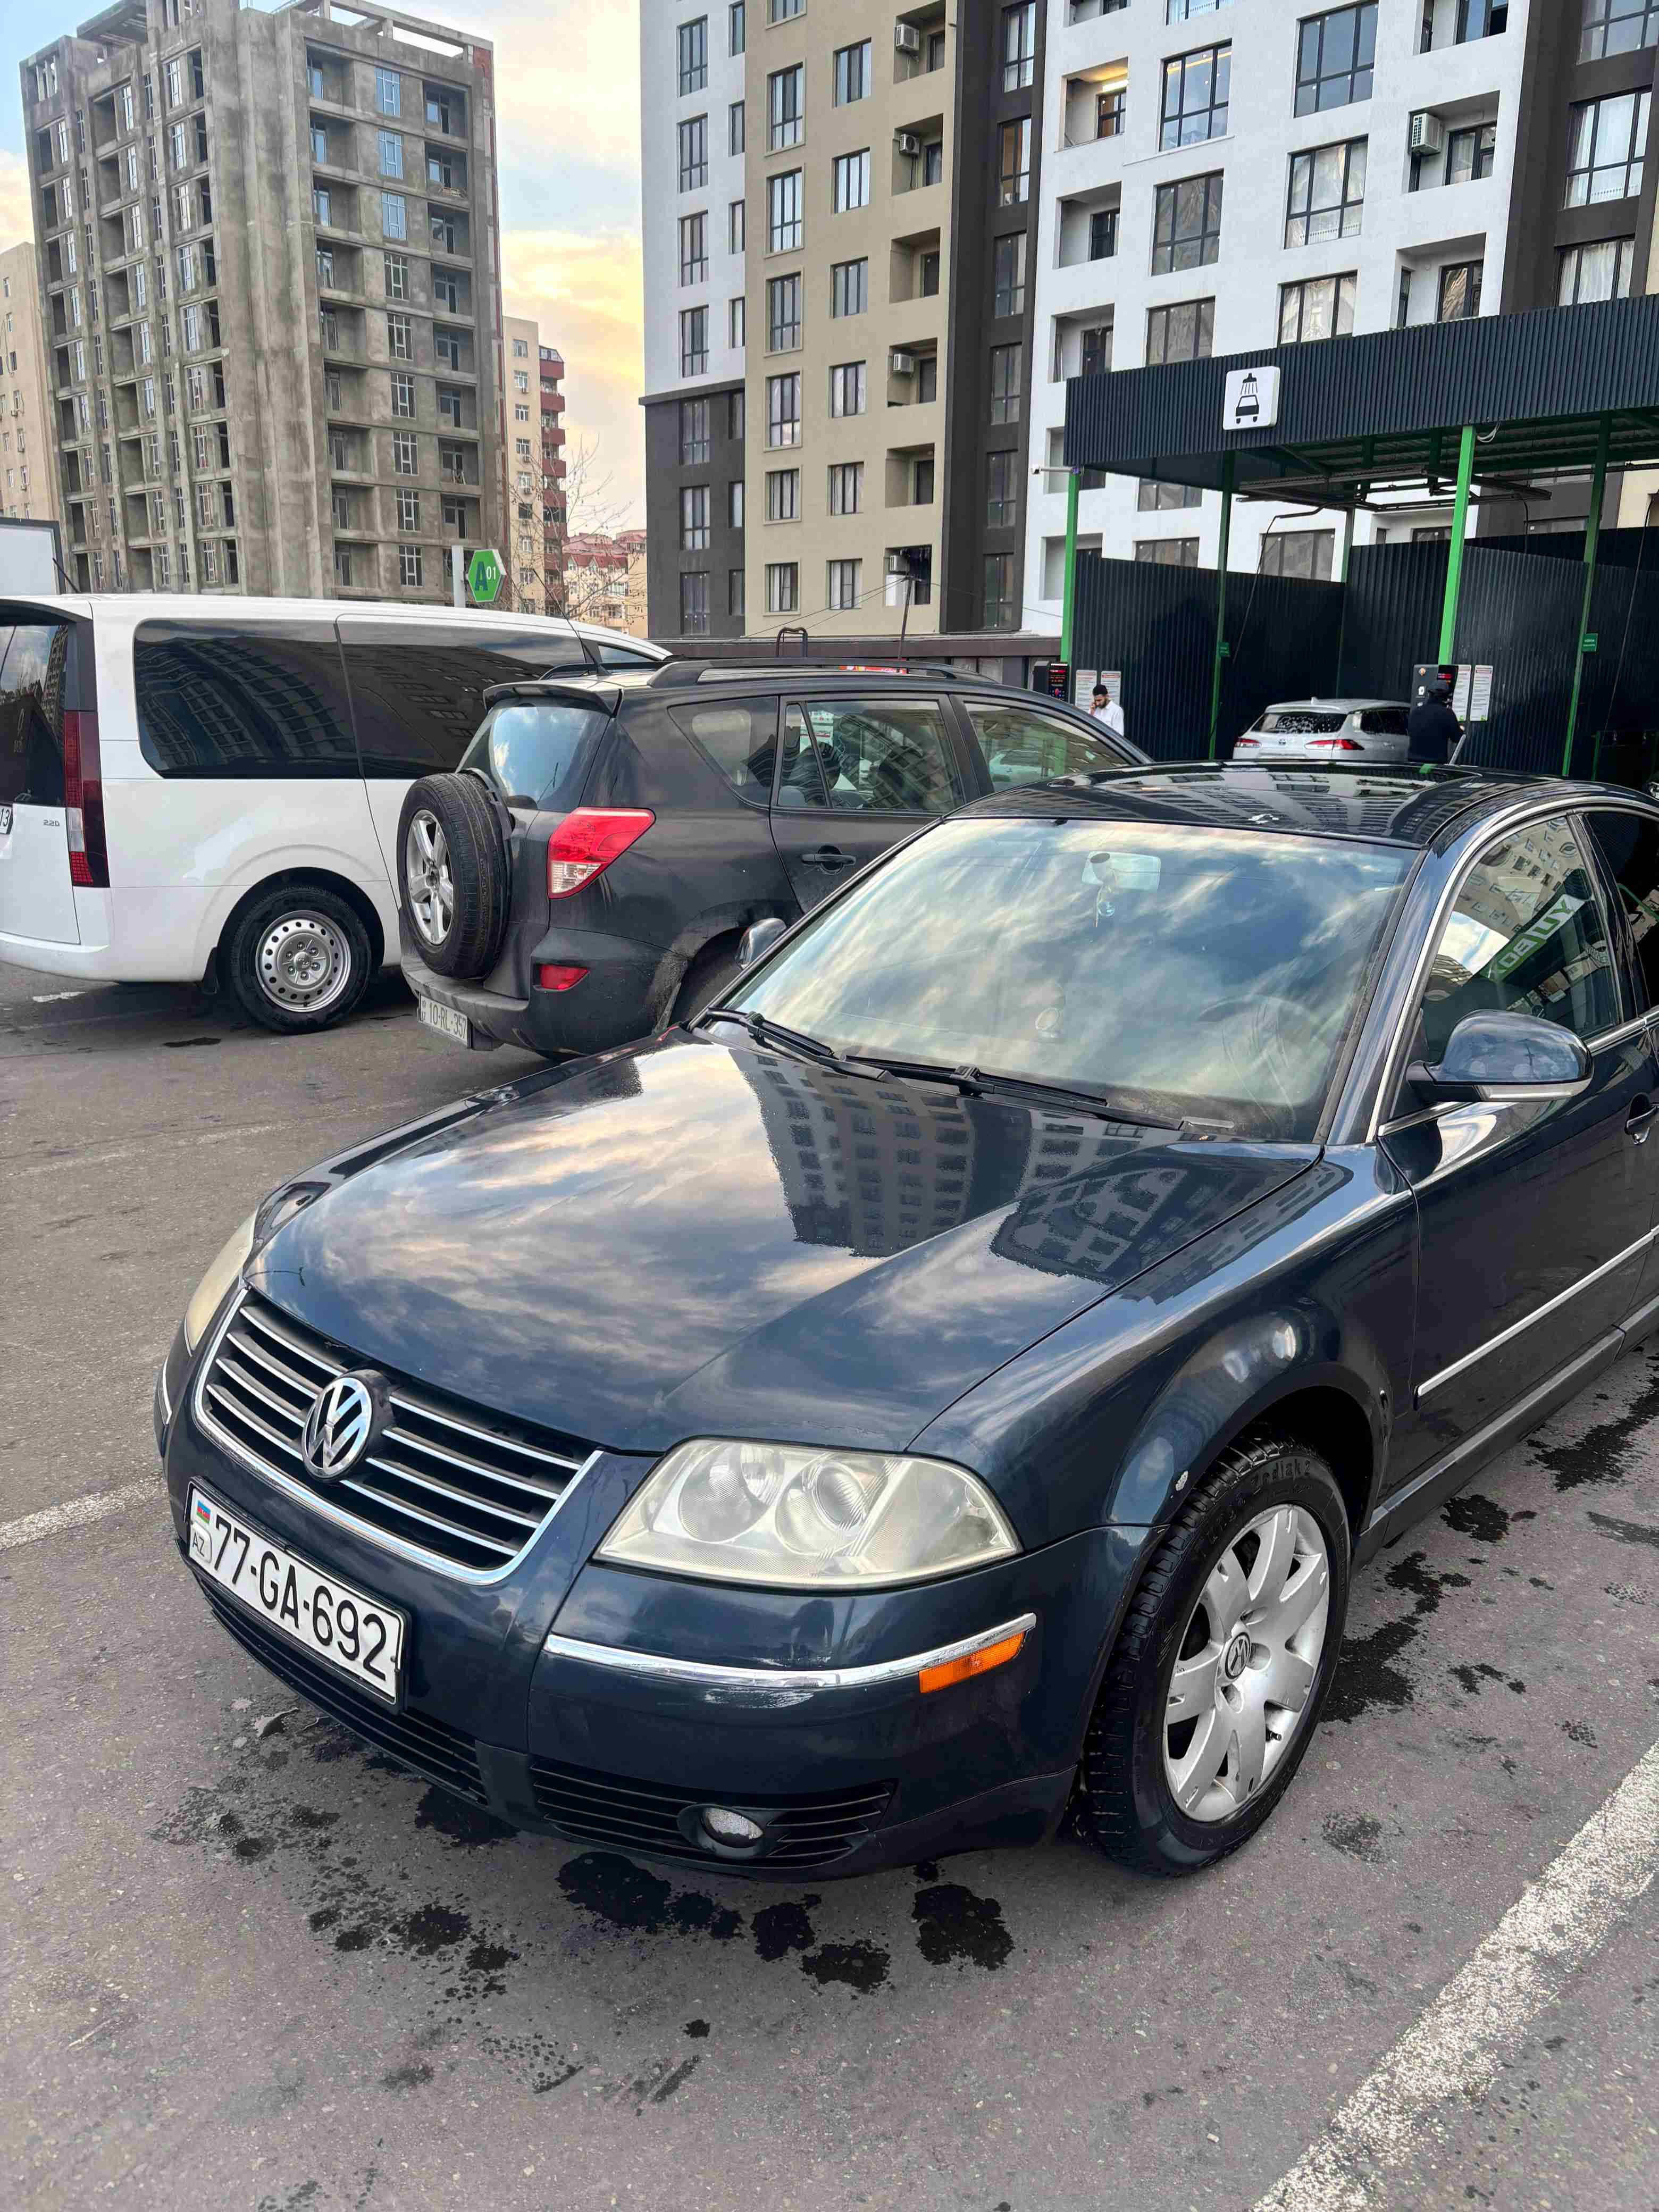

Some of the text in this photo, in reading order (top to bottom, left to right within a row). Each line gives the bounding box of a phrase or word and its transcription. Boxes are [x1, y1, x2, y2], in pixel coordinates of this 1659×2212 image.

[429, 1002, 467, 1039] 10-RL-357
[192, 1531, 206, 1557] AZ
[214, 1514, 387, 1681] 77-GA-692
